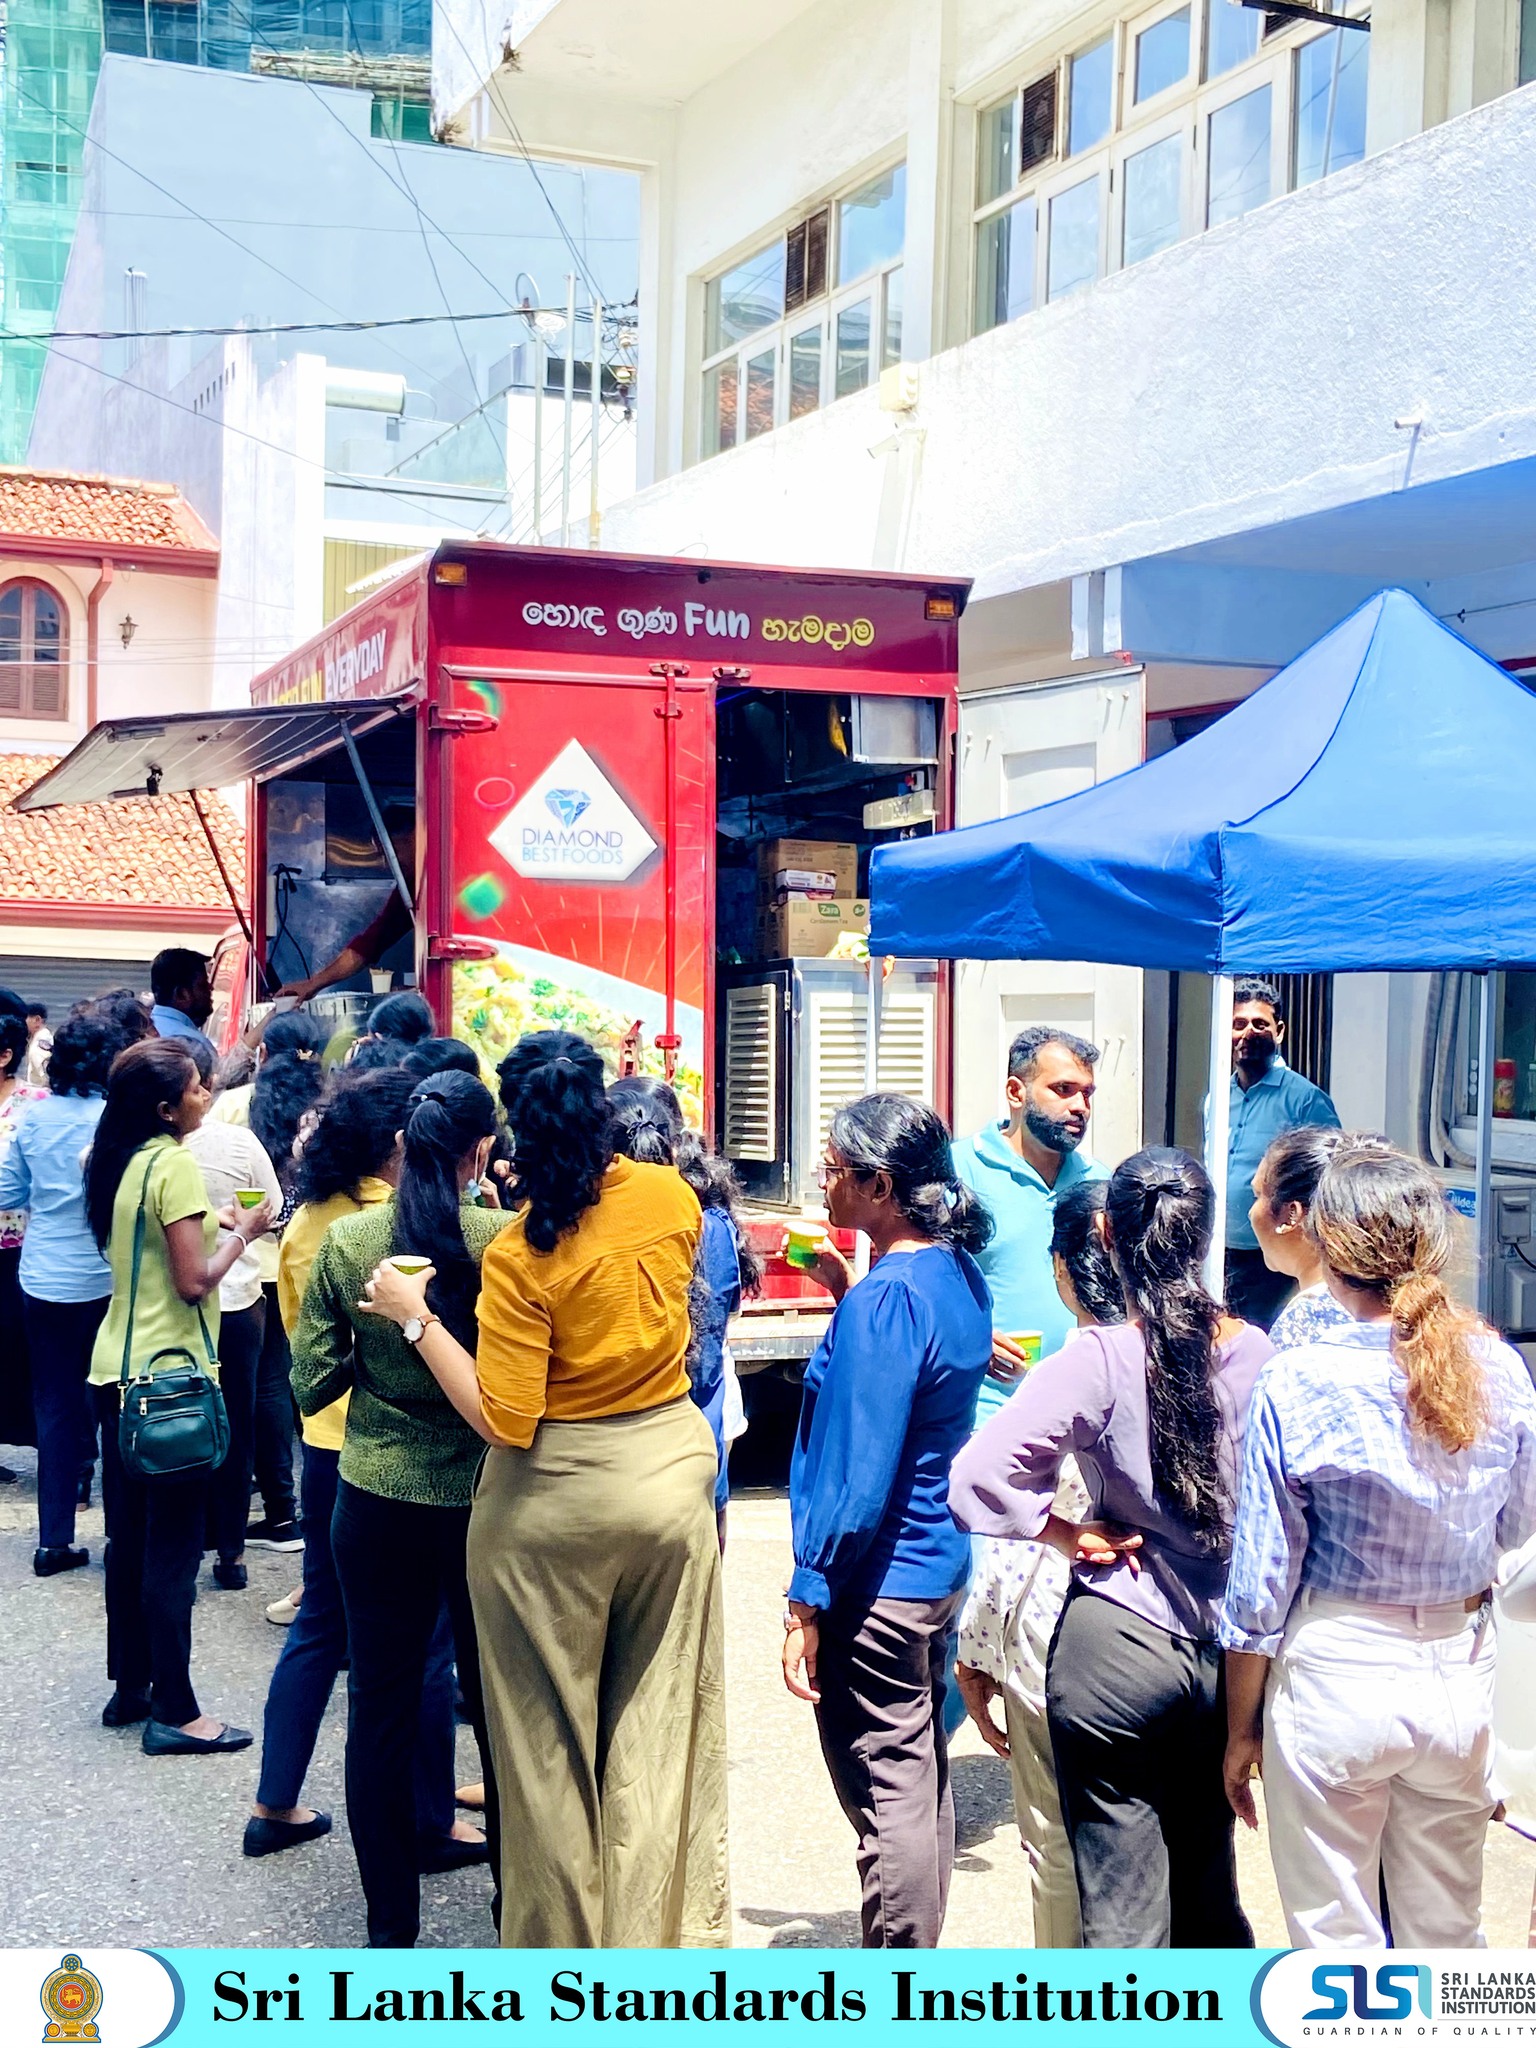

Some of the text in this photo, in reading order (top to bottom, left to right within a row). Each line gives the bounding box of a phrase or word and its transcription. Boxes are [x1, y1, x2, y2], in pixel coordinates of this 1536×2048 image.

[522, 601, 875, 651] හොඳ ගුණ Fun හැමදාම
[325, 628, 387, 701] EVERYDAY
[522, 828, 623, 848] DIAMOND
